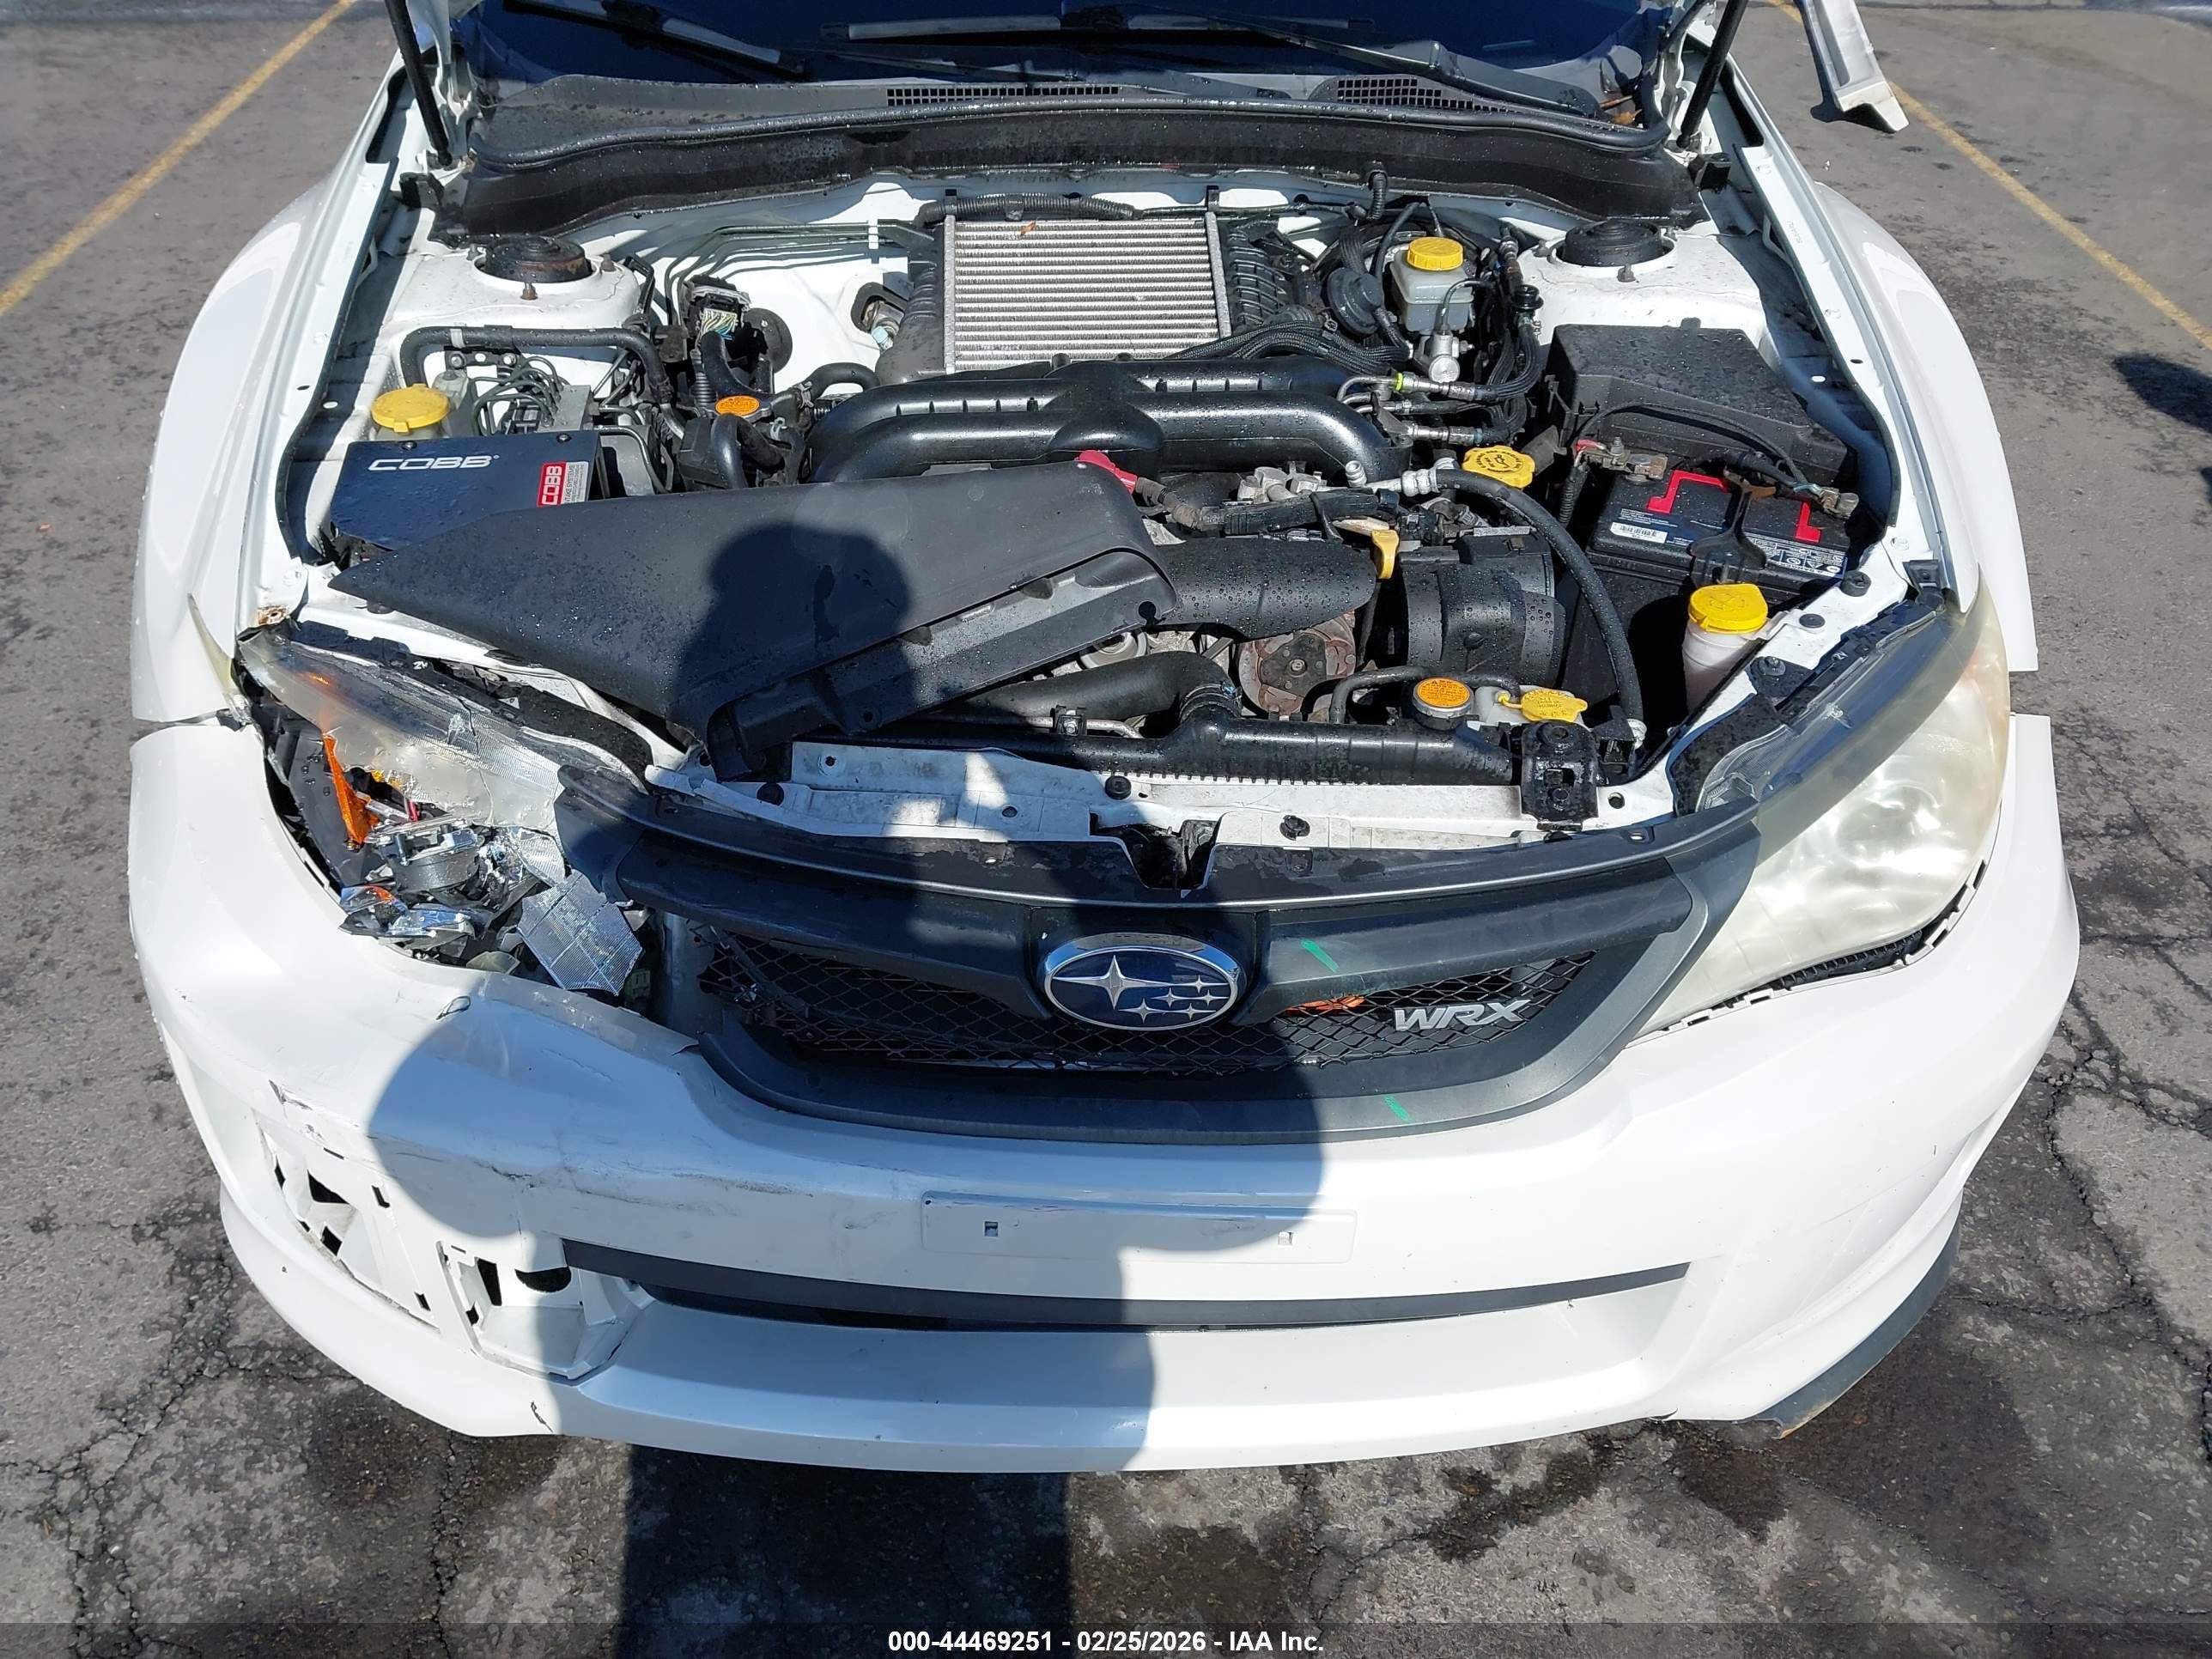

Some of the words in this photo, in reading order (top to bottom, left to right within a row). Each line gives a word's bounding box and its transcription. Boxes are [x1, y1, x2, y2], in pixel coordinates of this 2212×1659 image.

[368, 455, 493, 471] COBB
[541, 465, 562, 505] COBB
[1395, 999, 1532, 1032] WRX
